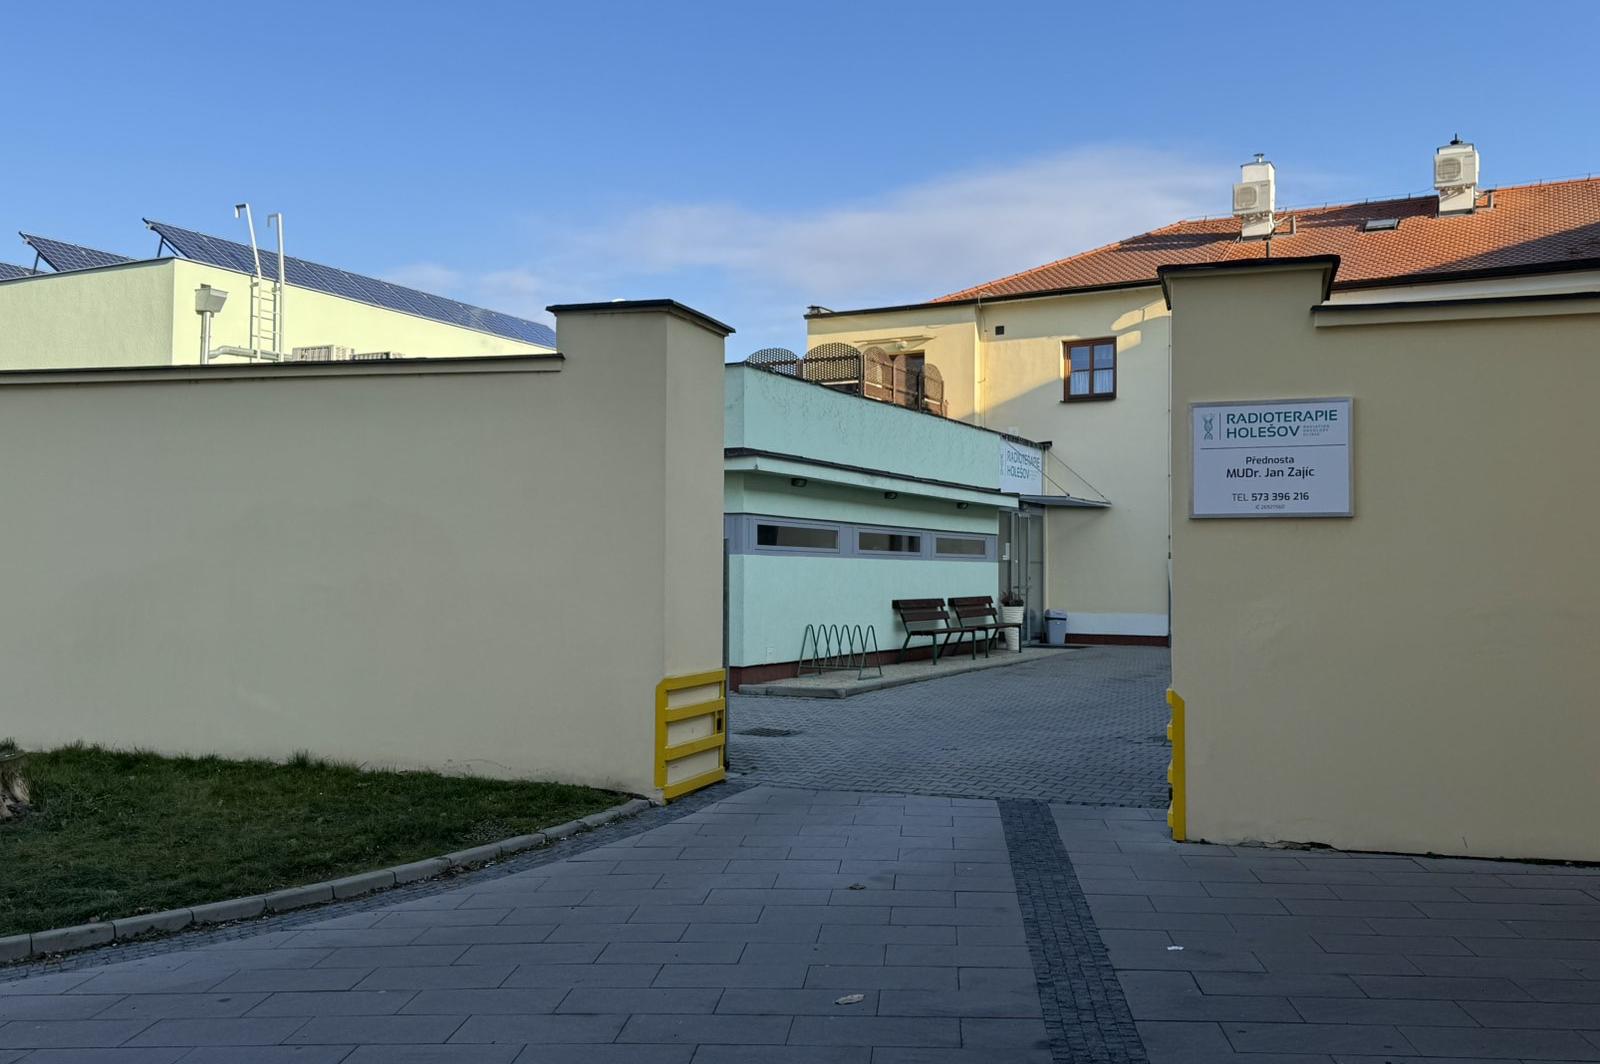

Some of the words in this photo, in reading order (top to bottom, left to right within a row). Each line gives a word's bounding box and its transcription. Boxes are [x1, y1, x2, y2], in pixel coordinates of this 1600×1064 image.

[1226, 409, 1338, 424] RADIOTERAPIE
[1226, 423, 1300, 439] HOLEŠOV
[1007, 450, 1040, 468] RADIOTERAPIE
[1245, 456, 1295, 465] Přednosta
[1007, 465, 1030, 479] HOLEŠOV
[1226, 468, 1262, 479] MUDr.
[1264, 467, 1284, 478] Jan
[1287, 466, 1315, 480] Zajíc
[1232, 493, 1249, 502] TEL
[1251, 492, 1269, 502] 573
[1272, 492, 1290, 501] 396
[1293, 491, 1309, 501] 216
